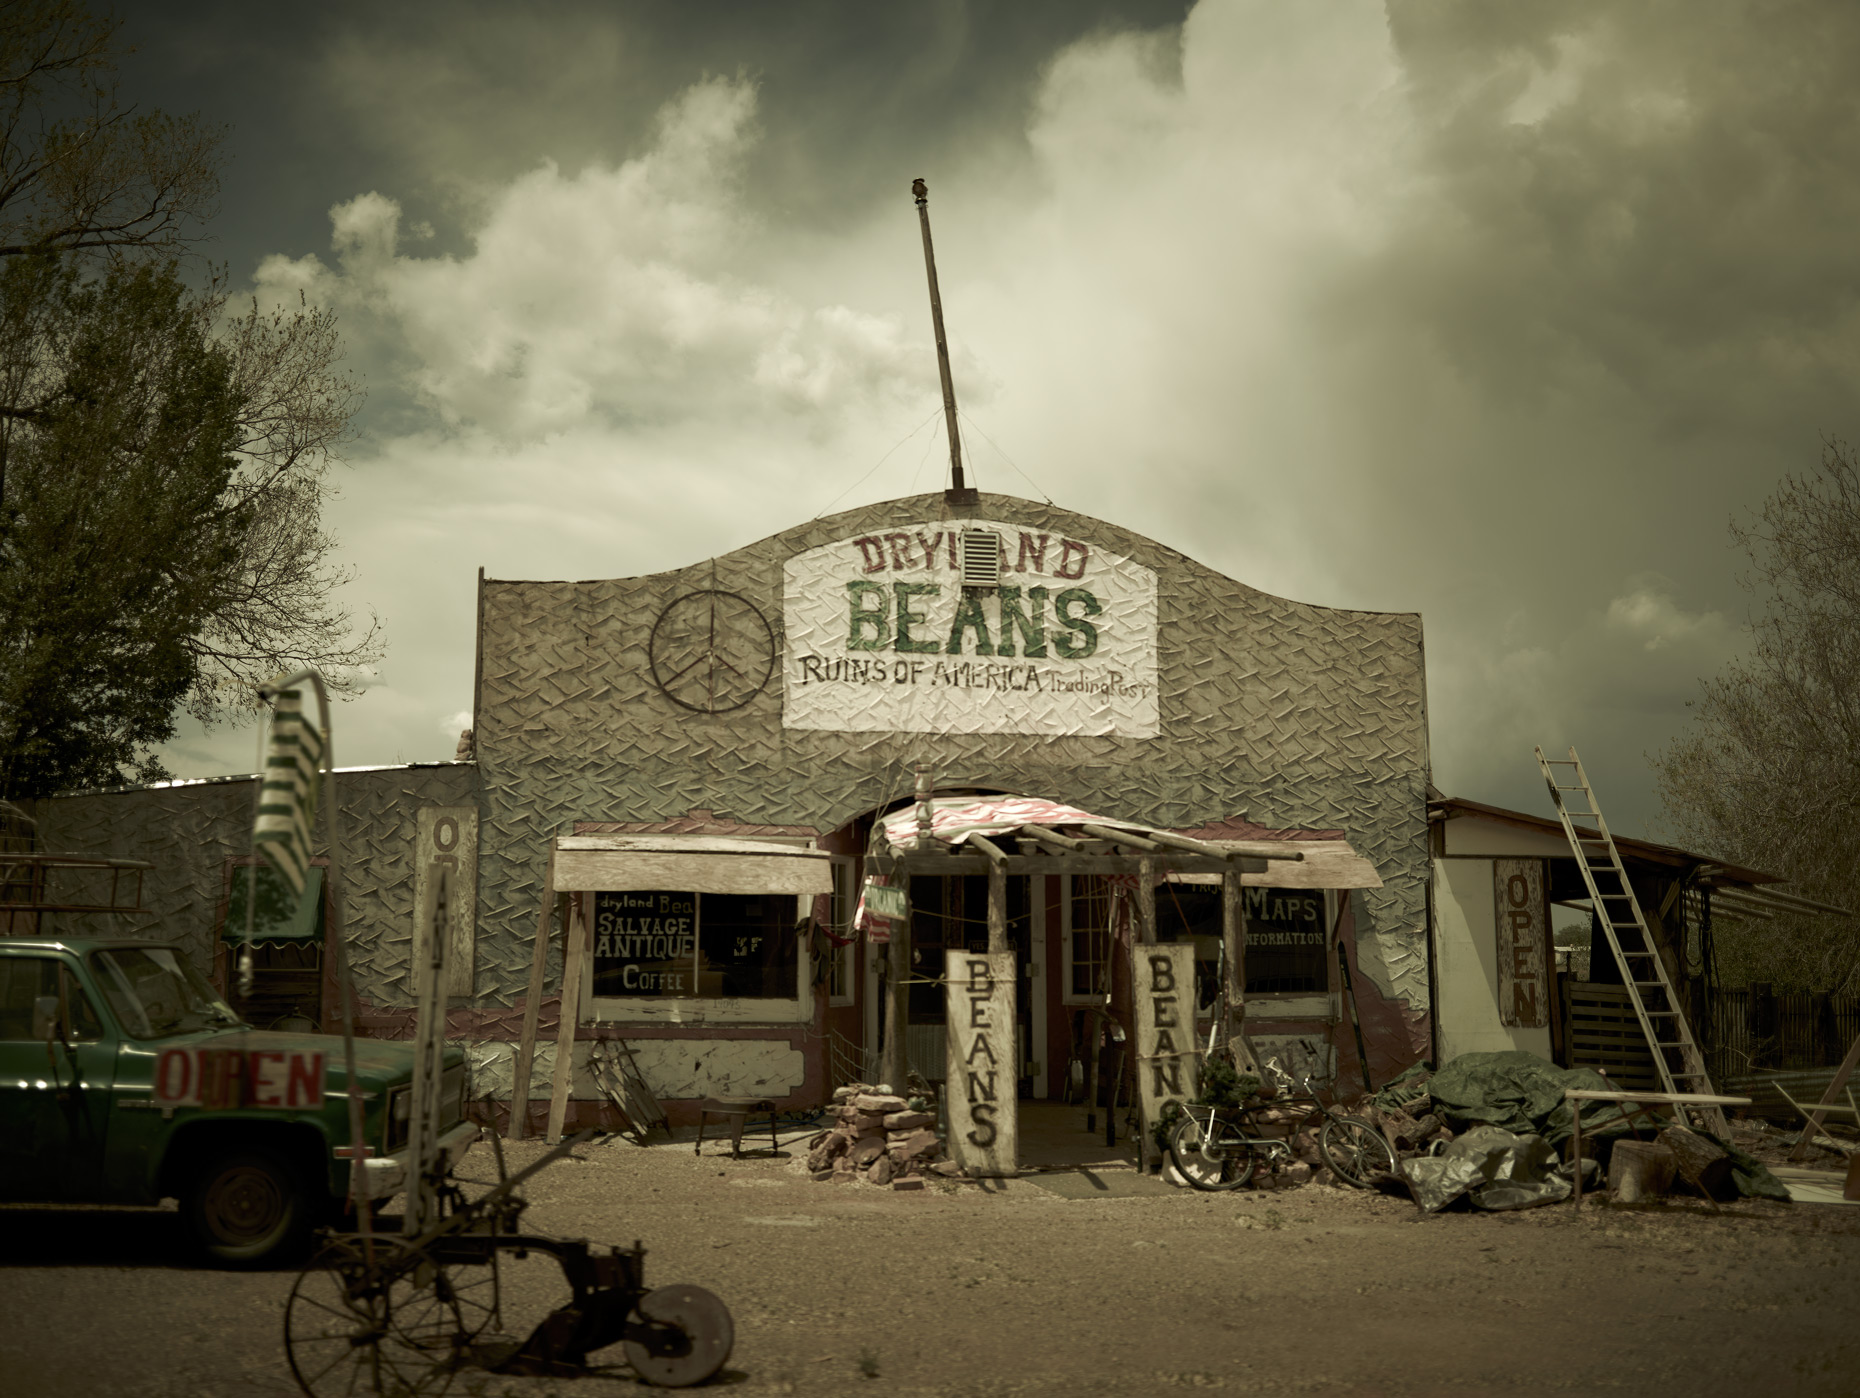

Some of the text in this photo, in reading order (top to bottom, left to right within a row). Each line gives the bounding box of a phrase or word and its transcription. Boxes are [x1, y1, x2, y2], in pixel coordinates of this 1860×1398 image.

[845, 580, 1103, 660] BEANS
[800, 655, 887, 686] RUINS
[894, 660, 925, 685] OF
[931, 661, 1043, 692] AMERICA
[601, 894, 654, 912] dryland
[1244, 888, 1318, 921] MAPS
[597, 912, 691, 936] SALVAGE
[594, 935, 694, 960] ANTIQUE
[1245, 932, 1325, 946] NFORMATION
[1506, 874, 1537, 1024] OPEN
[622, 964, 685, 990] COFFEE
[965, 959, 999, 1149] BEANS
